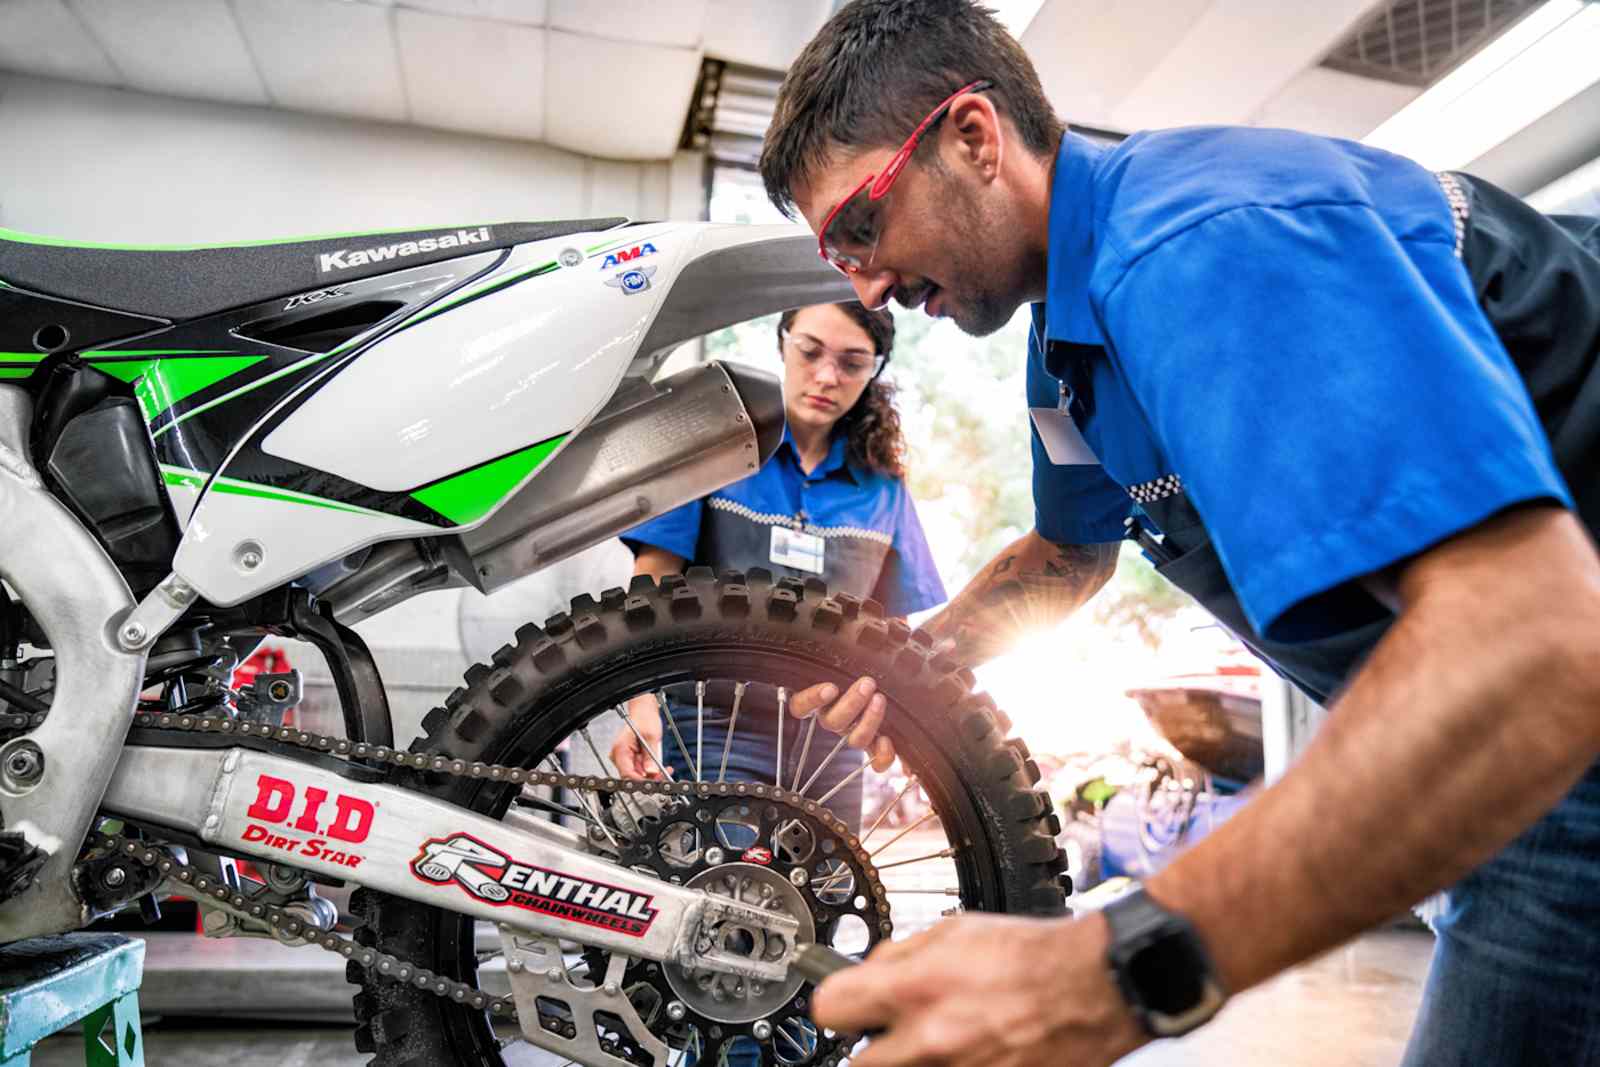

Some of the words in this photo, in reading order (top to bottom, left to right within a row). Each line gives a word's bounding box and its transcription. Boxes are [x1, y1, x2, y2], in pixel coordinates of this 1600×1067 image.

[320, 227, 490, 272] Kawasaki
[601, 242, 656, 269] AMA
[247, 773, 375, 844] D.I.D
[513, 893, 643, 933] CHAINWHEELS
